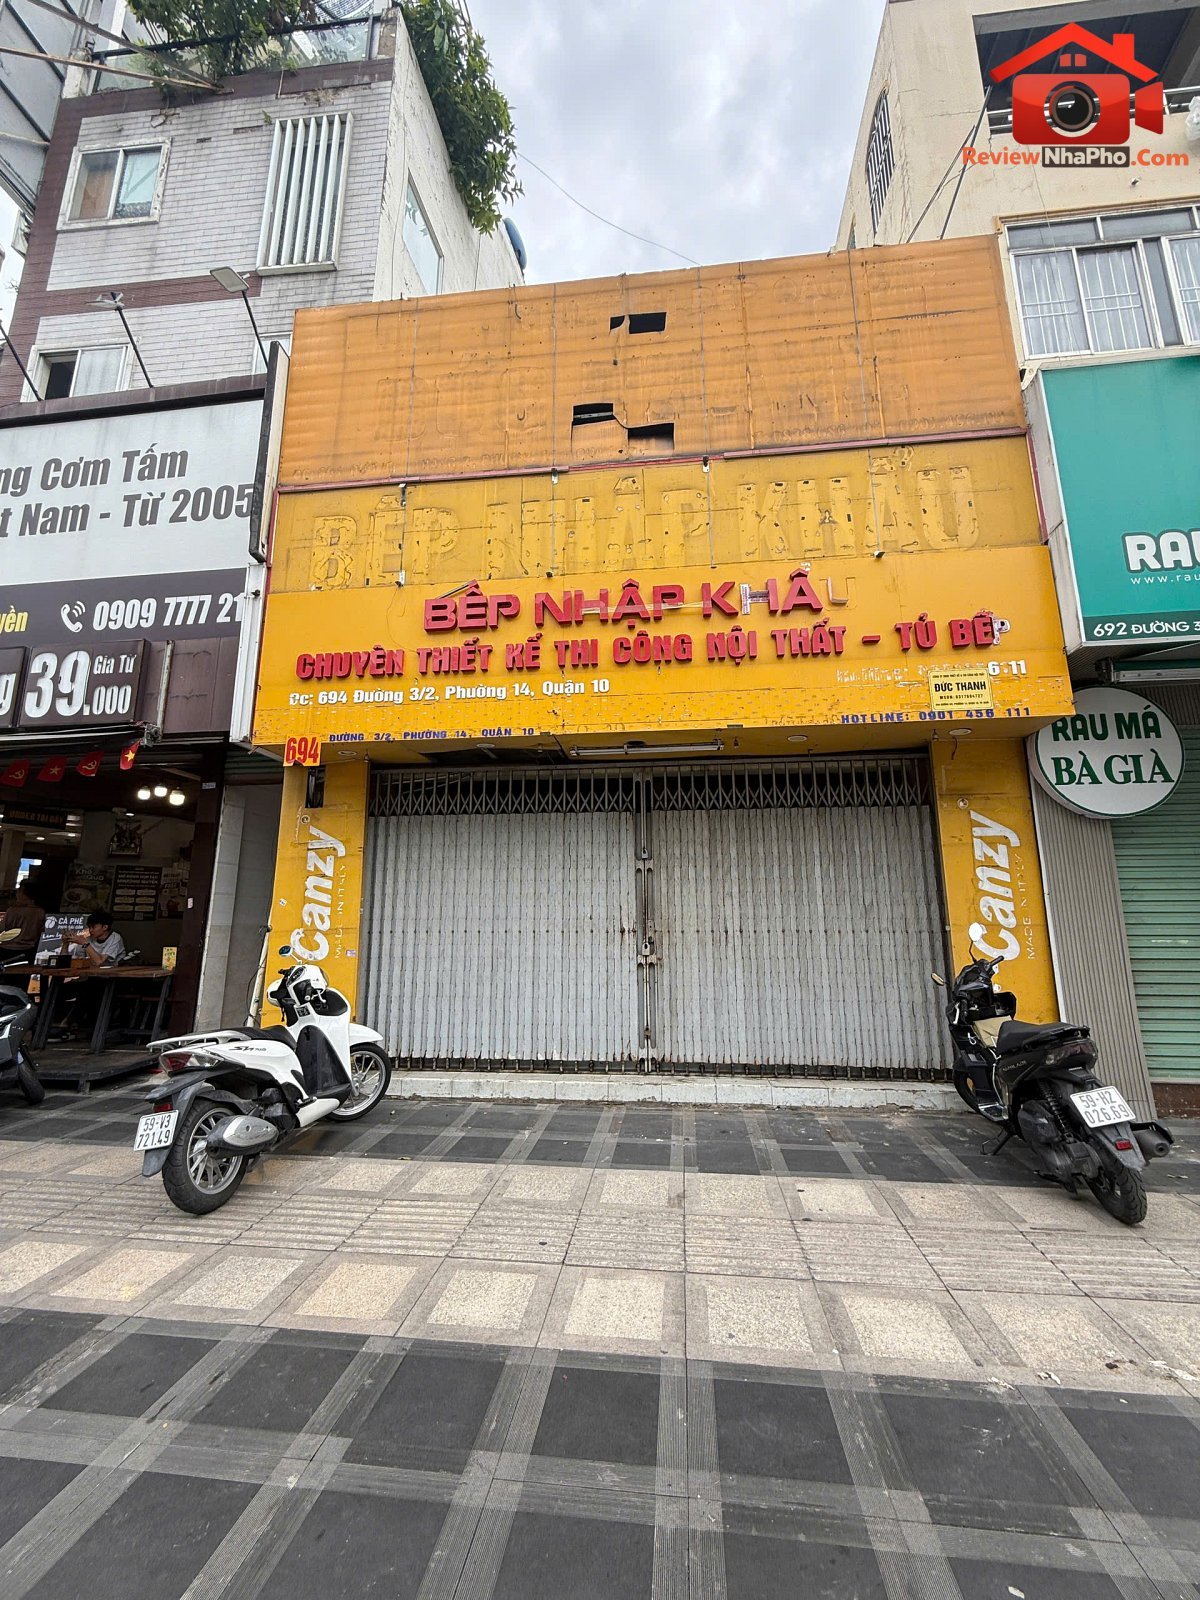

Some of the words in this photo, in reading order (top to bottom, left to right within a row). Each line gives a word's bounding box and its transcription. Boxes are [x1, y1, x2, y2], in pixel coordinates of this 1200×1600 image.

[40, 456, 111, 491] Cơm
[122, 442, 189, 484] Tấm
[18, 501, 91, 537] Nam
[122, 491, 165, 528] Từ
[169, 483, 255, 523] 2005
[93, 598, 157, 631] 0909
[163, 594, 210, 627] 7777
[535, 578, 685, 629] NHẬP
[1093, 622, 1128, 637] 692
[1131, 620, 1190, 635] ĐƯỜNG
[296, 644, 405, 681] CHUYÊN
[417, 636, 494, 675] THIẾT
[506, 632, 543, 671] KẾ
[554, 638, 599, 668] THI
[613, 630, 692, 664] CÔNG
[706, 625, 757, 666] NỘI
[771, 617, 846, 657] THẤT
[894, 612, 938, 652] TỦ
[318, 690, 348, 705] 694
[353, 687, 404, 705] Đường
[409, 686, 440, 702] 3/2,
[445, 684, 507, 700] Phường
[512, 682, 535, 698] 14,
[542, 679, 585, 697] Quận
[591, 678, 610, 693] 10
[934, 681, 953, 692] ĐỨC
[955, 681, 987, 692] THANH
[841, 712, 910, 724] HOTLINE:
[919, 710, 954, 721] 0901
[965, 708, 995, 718] 456
[1006, 707, 1030, 718] 111
[1051, 712, 1108, 742] RAU
[1114, 704, 1162, 740] MÁ
[286, 737, 319, 764] 694
[329, 731, 364, 742] ĐƯỜNG
[403, 729, 447, 740] PHƯỜNG
[522, 728, 534, 736] 10
[1050, 750, 1101, 786] BÀ
[1103, 748, 1175, 785] GIÀ
[290, 825, 346, 961] Canzy
[970, 810, 1021, 961] Canzy
[1079, 1091, 1117, 1109] 59-H2
[1084, 1104, 1130, 1124] 026.69
[137, 1130, 171, 1149] 721.49
